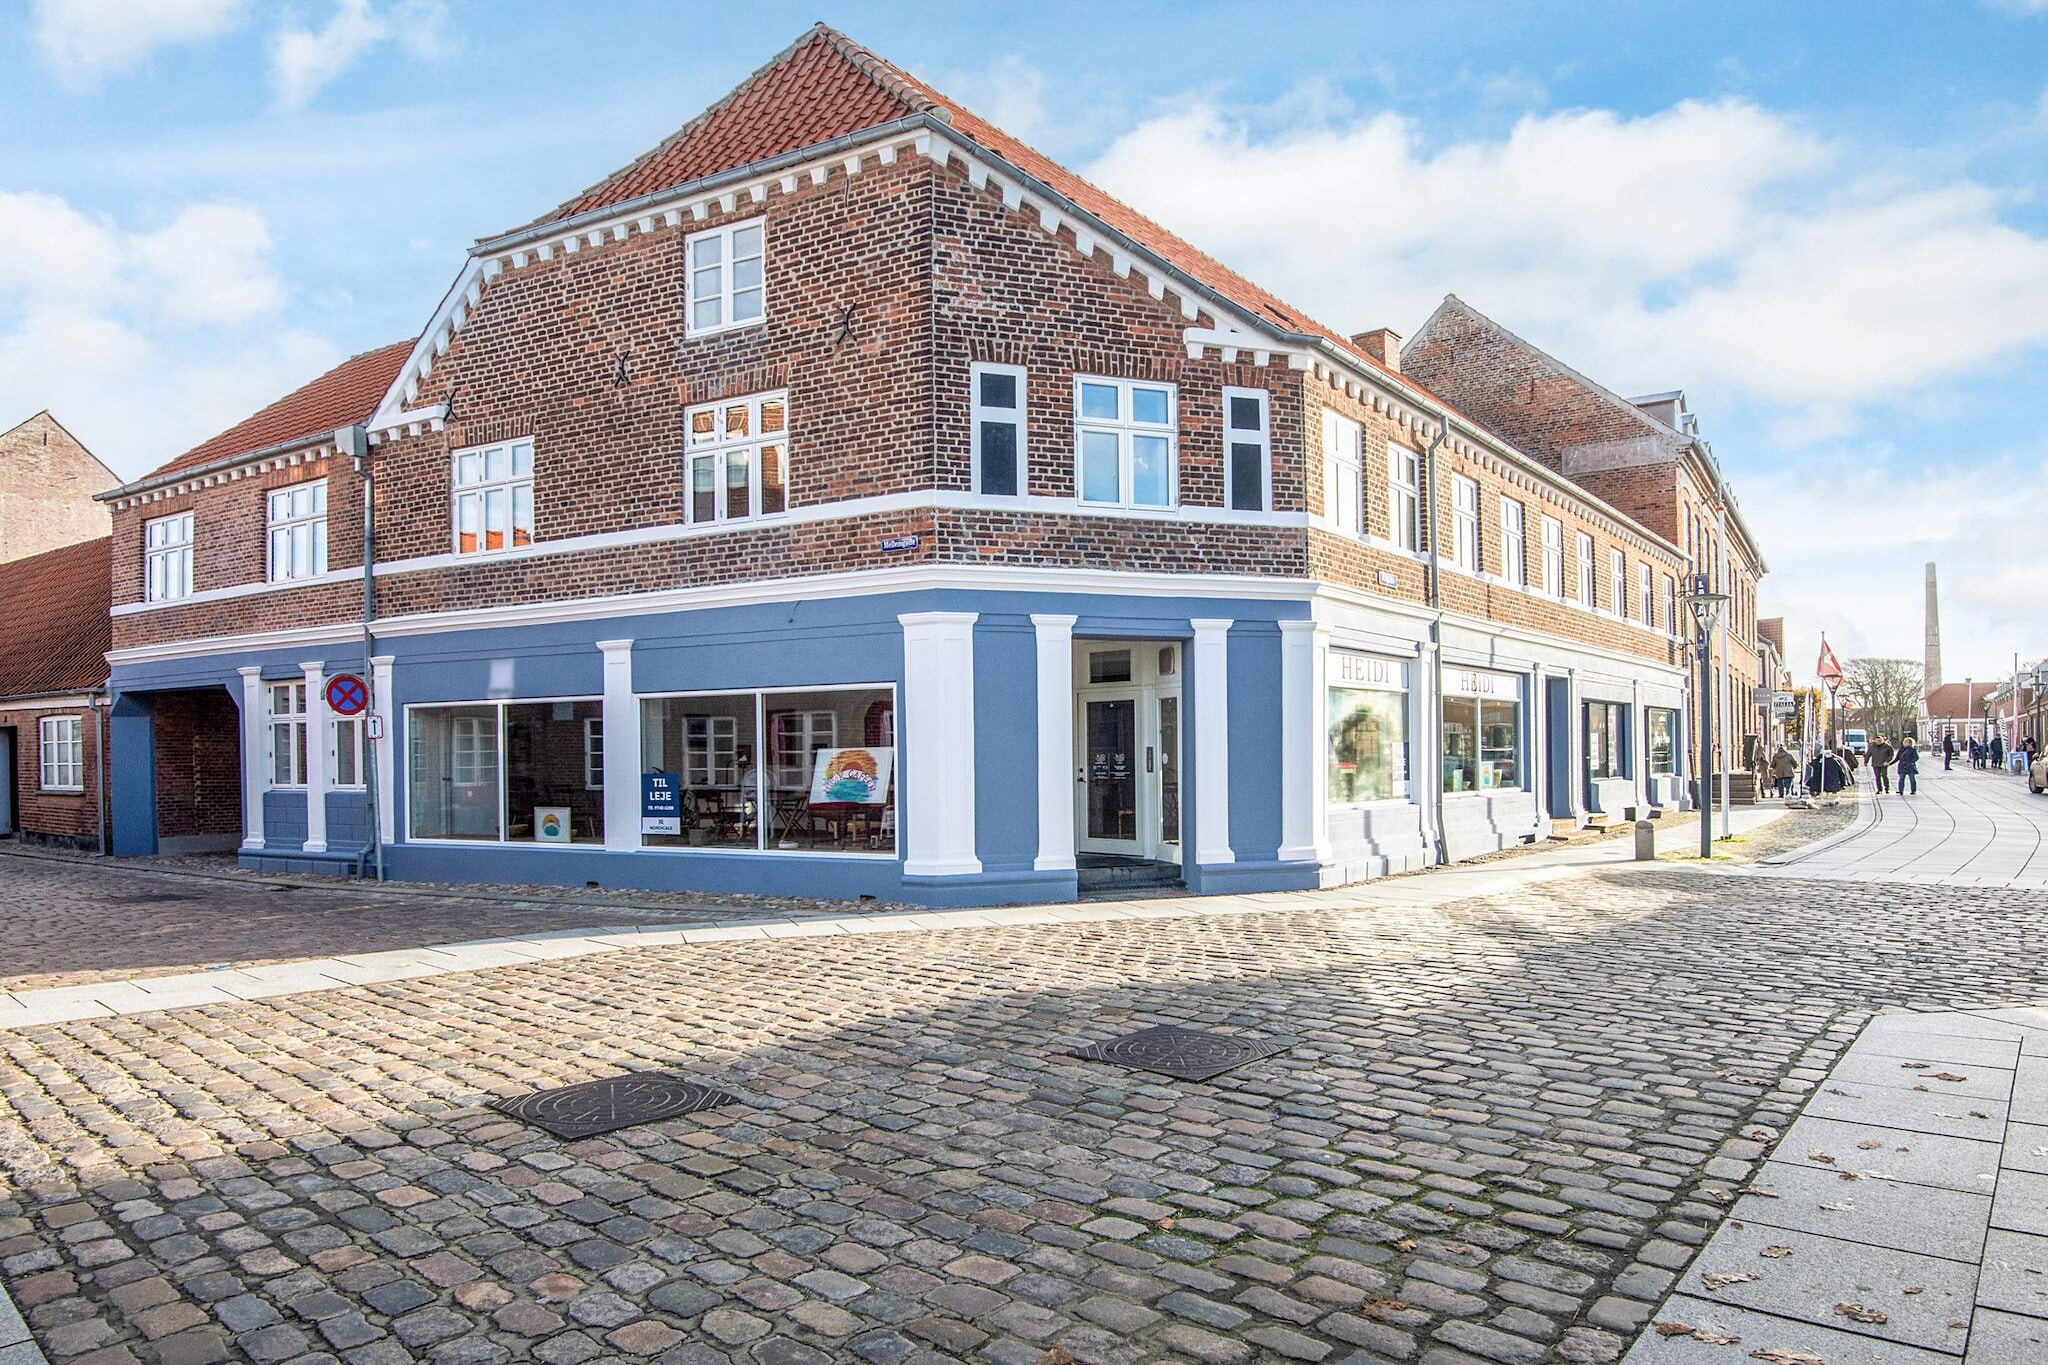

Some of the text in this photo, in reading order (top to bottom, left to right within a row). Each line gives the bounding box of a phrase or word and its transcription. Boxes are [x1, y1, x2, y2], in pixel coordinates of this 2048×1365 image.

[1341, 656, 1389, 683] HEIDI
[1461, 672, 1494, 693] HEIDI
[652, 778, 669, 788] TIL
[649, 791, 672, 801] LEJE
